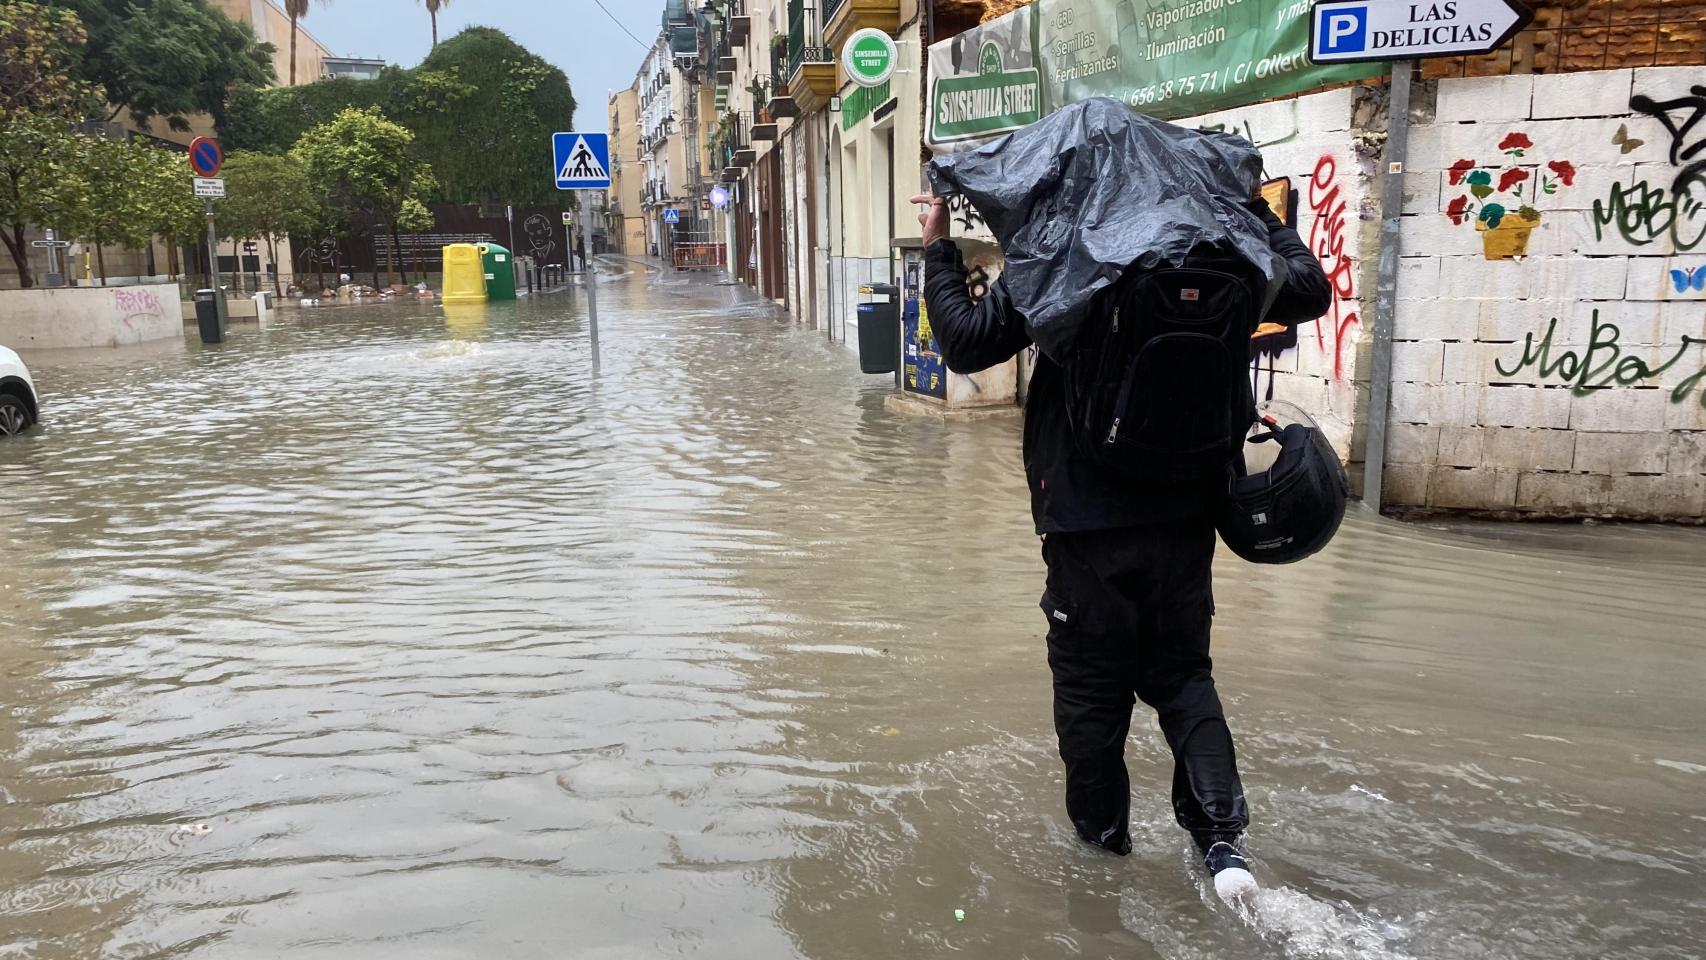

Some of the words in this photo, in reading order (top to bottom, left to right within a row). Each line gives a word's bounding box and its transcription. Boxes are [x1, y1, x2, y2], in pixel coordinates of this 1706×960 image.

[1056, 8, 1073, 29] CBD
[1275, 7, 1287, 31] y
[1408, 1, 1457, 23] LAS
[1055, 31, 1095, 57] Semillas
[1145, 25, 1225, 61] Iluminación
[1328, 14, 1358, 48] P
[1371, 22, 1492, 49] DELICIAS
[854, 50, 888, 58] SINSEMILLA
[861, 59, 881, 67] STREET
[1055, 54, 1118, 83] Fertilizantes
[1130, 85, 1155, 106] 656
[1157, 80, 1174, 101] 58
[1178, 75, 1196, 97] 75
[1199, 70, 1218, 93] 71
[1234, 61, 1253, 84] C/
[1255, 44, 1313, 79] Ollerí
[1004, 83, 1037, 116] STREET
